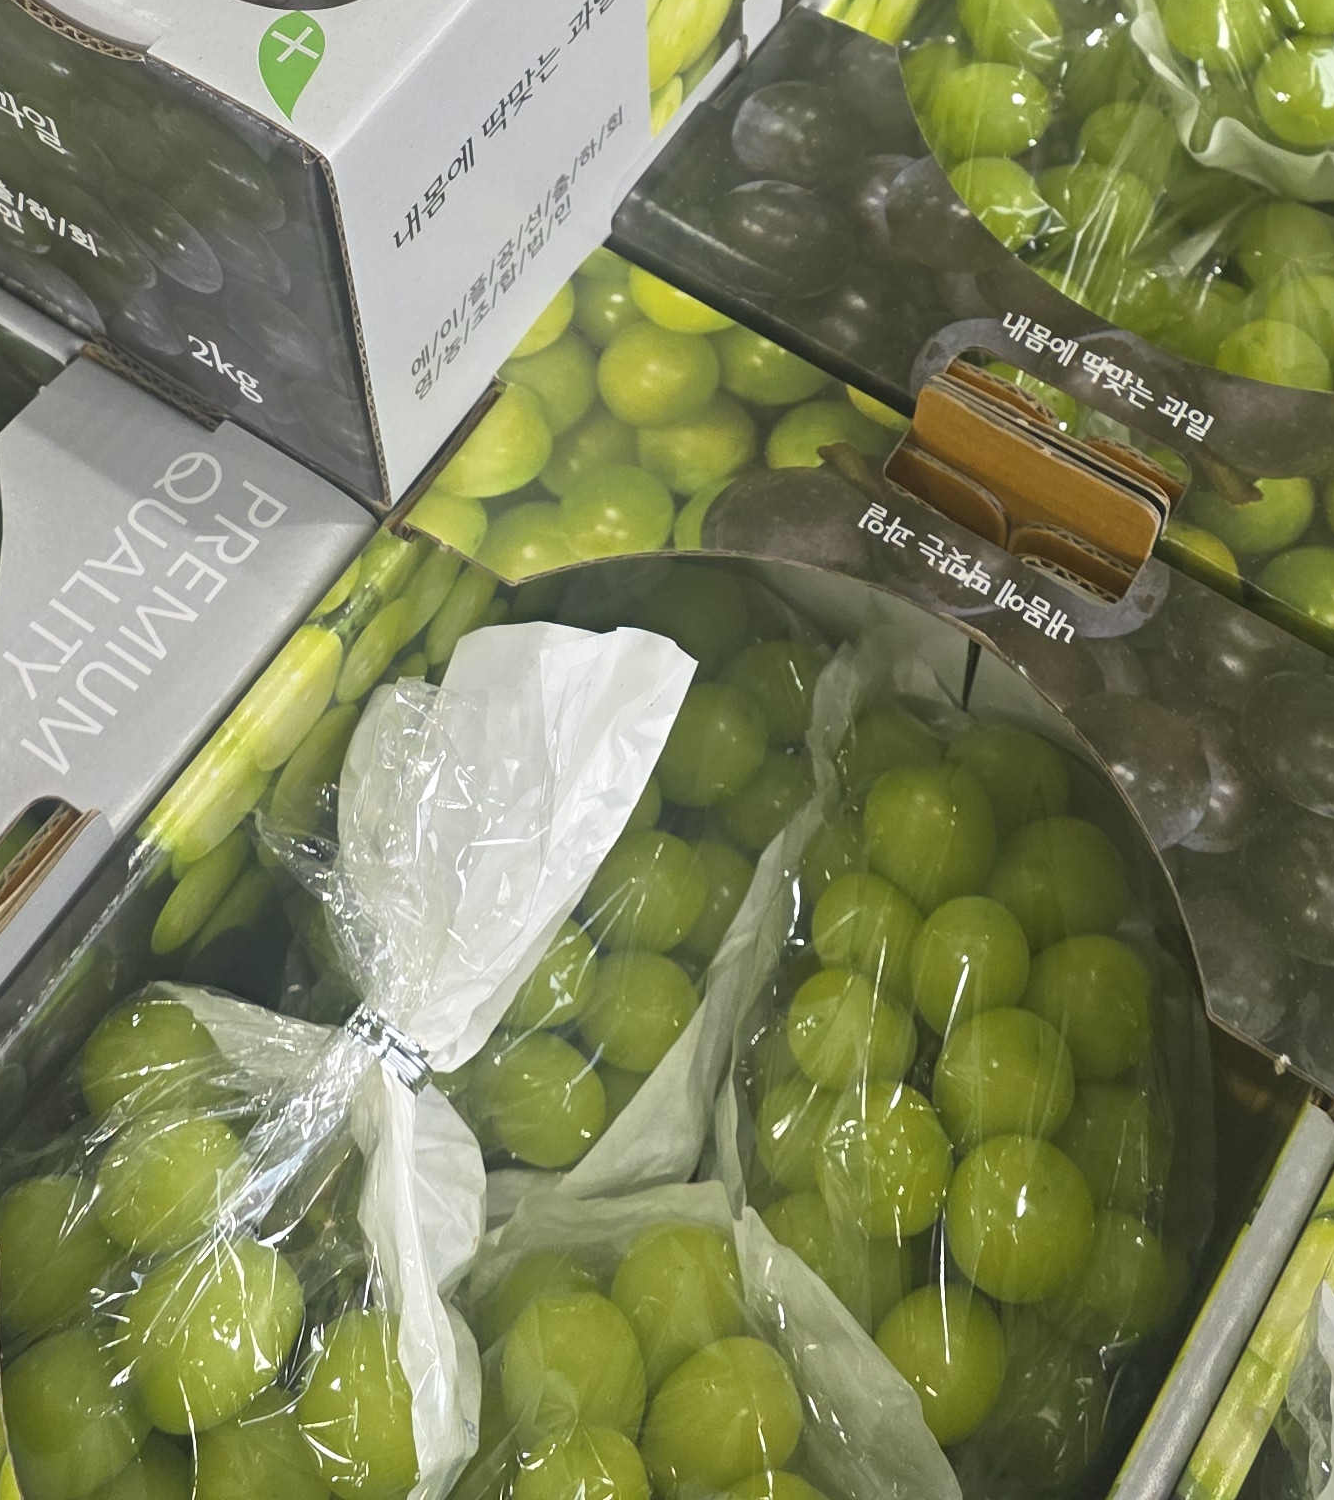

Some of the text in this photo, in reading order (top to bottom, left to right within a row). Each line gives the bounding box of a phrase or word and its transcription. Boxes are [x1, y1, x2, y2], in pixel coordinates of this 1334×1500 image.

[393, 136, 475, 250] 내몸에
[481, 46, 561, 140] 딱맞는
[188, 334, 264, 404] 2kg
[1002, 312, 1215, 442] 내몸에 딱맞는 과일
[2, 451, 222, 701] QUALITY
[20, 480, 288, 776] PREMIUM
[857, 503, 1076, 644] 내몸에 딱맞는 과일
